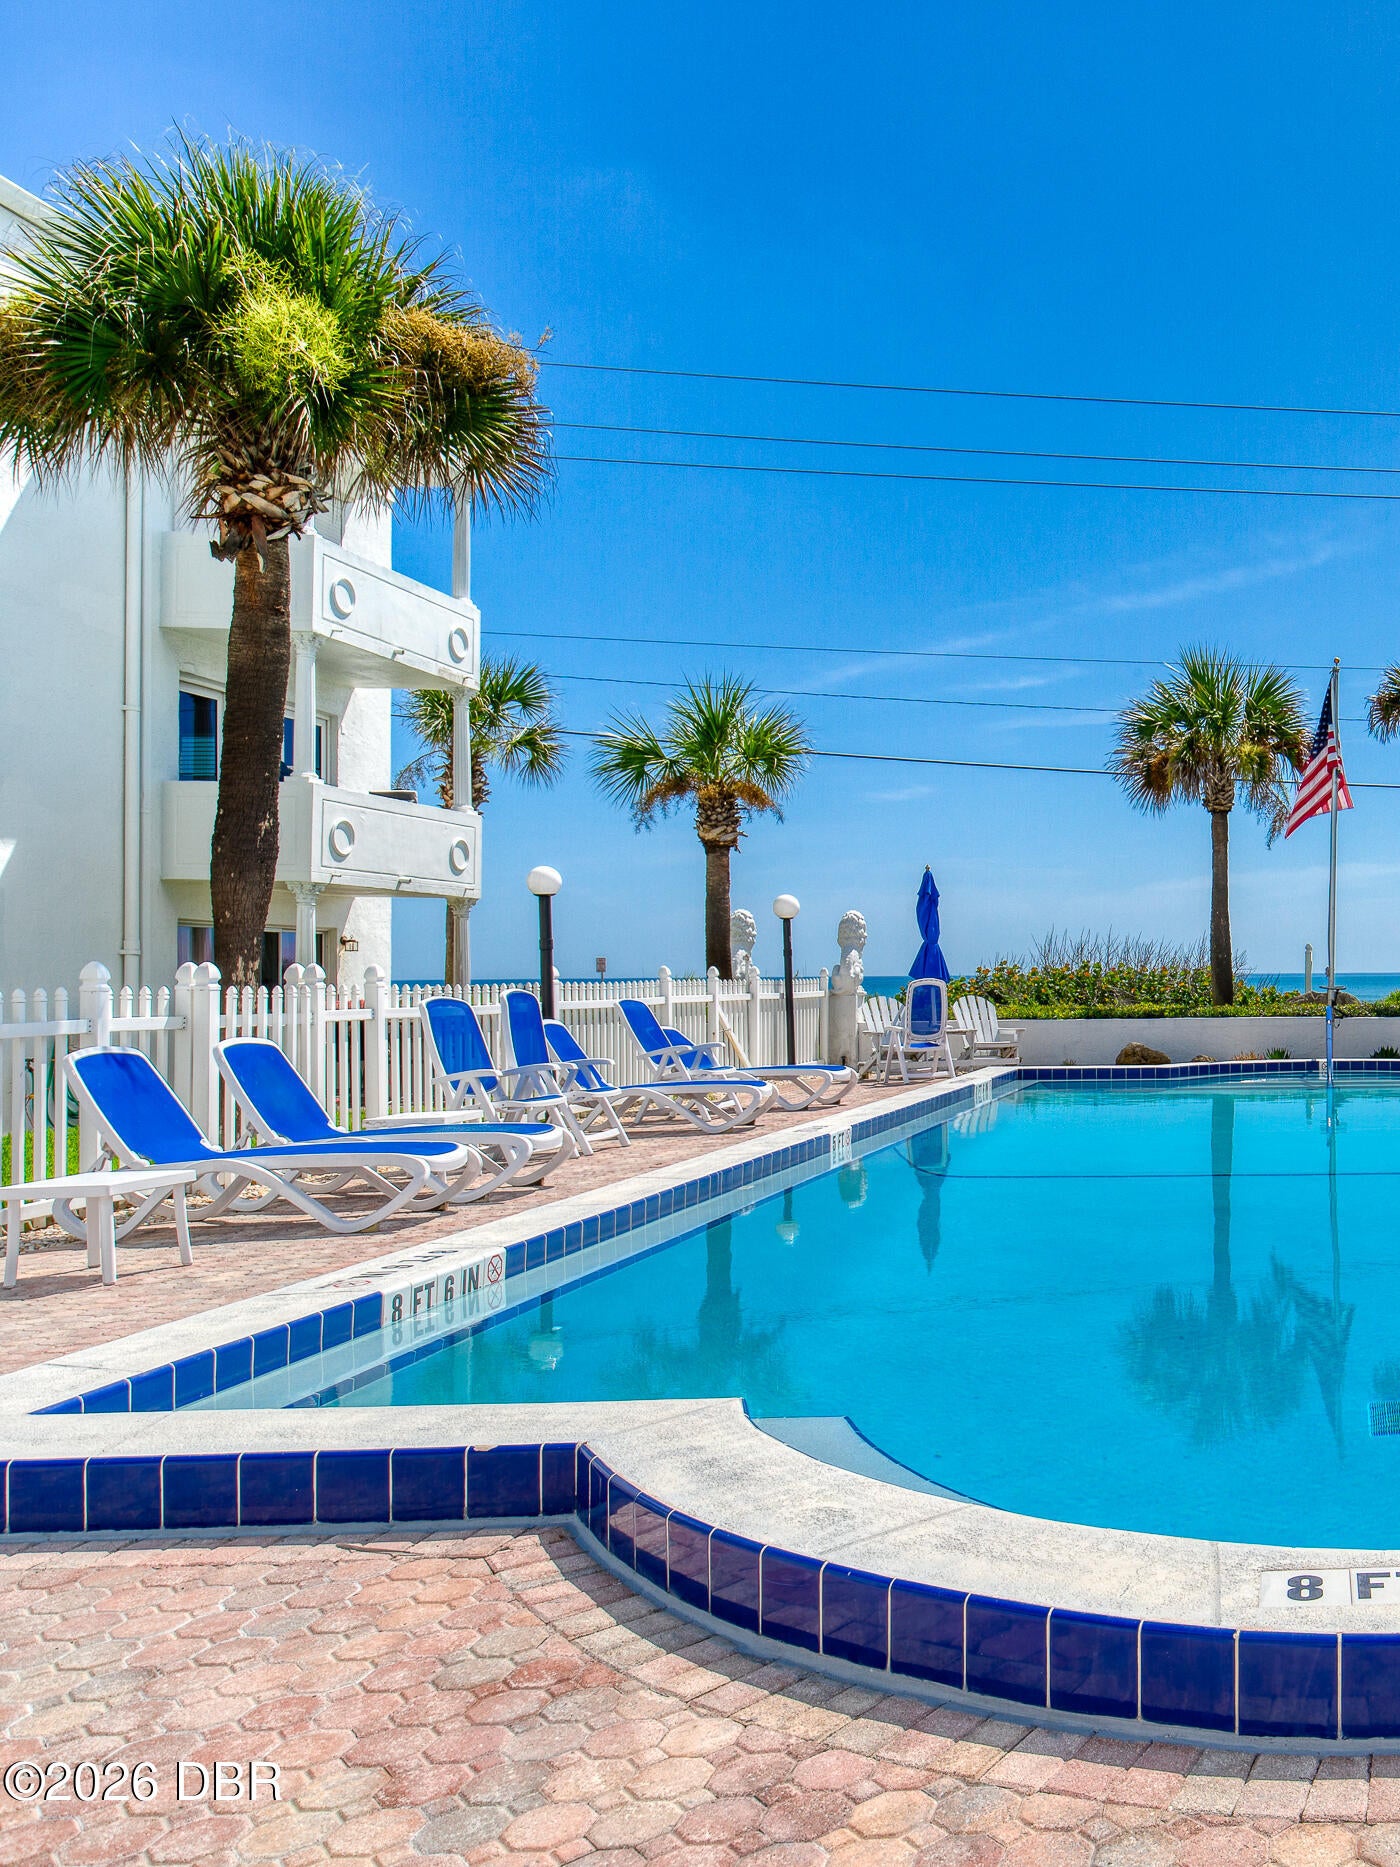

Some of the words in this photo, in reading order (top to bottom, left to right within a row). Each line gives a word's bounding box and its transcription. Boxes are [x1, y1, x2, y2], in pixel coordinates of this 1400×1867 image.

[391, 1293, 403, 1323] 8
[444, 1275, 455, 1302] 6
[1286, 1574, 1325, 1602] 8
